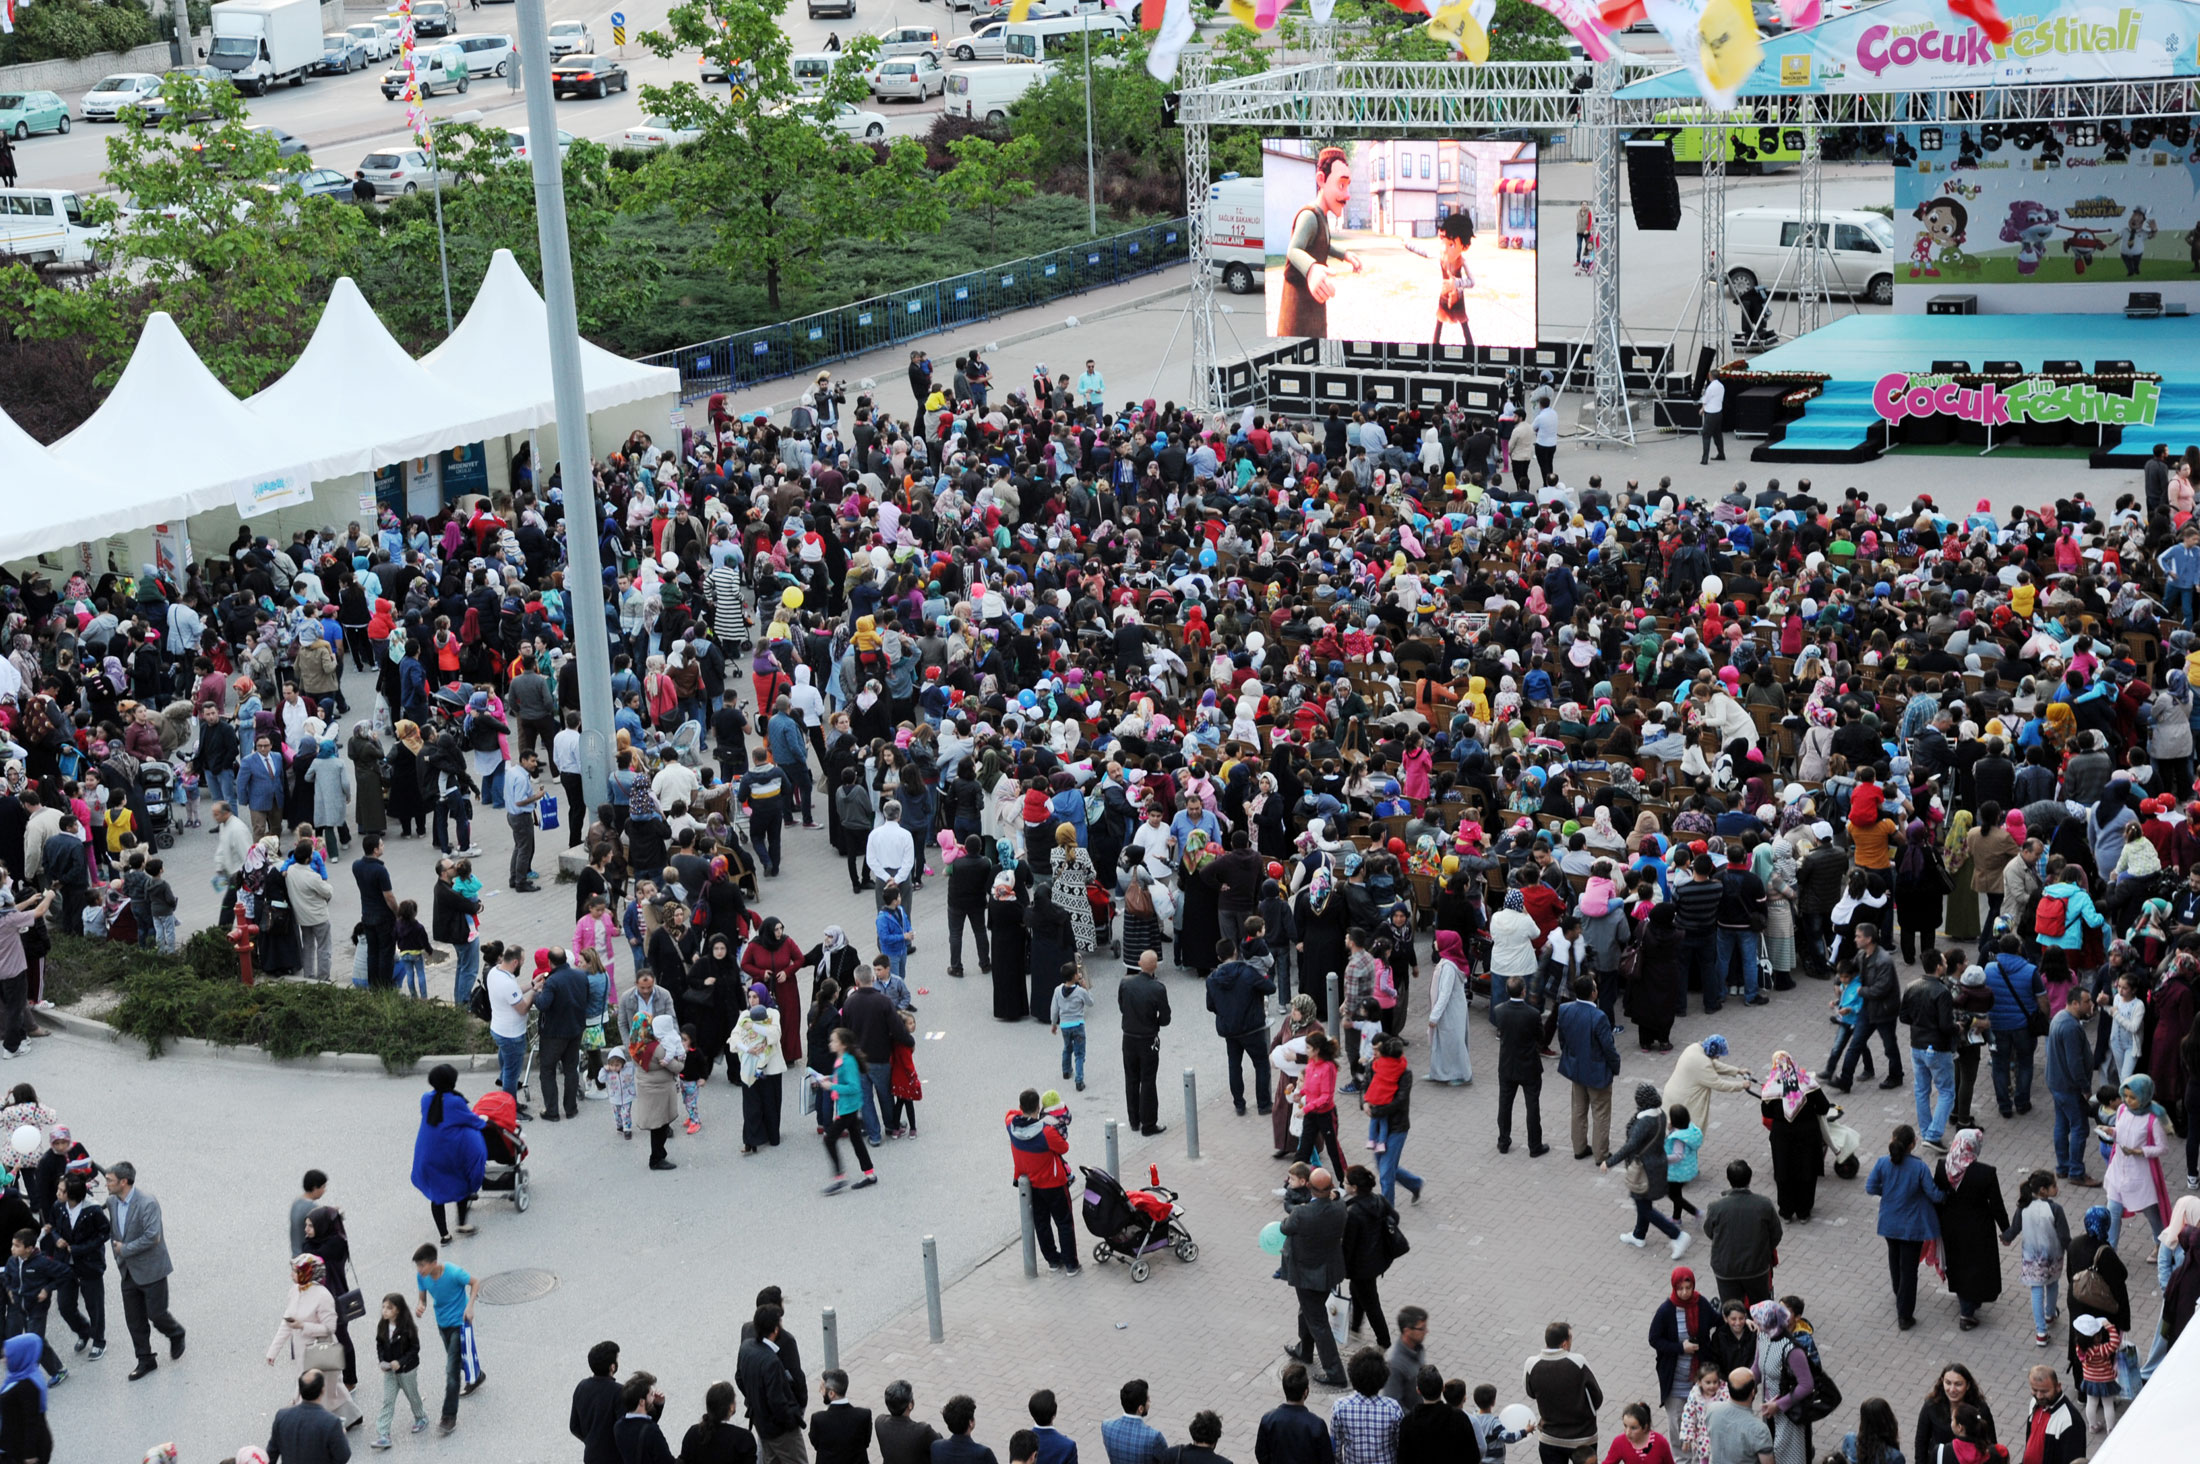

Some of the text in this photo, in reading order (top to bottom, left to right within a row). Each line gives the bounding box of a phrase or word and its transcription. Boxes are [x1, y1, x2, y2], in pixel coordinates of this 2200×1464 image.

[1892, 21, 1935, 37] Konya
[1856, 24, 1993, 77] Çocuk
[1232, 224, 1246, 236] 112
[1908, 376, 1952, 389] Konya
[1872, 372, 2161, 427] Çocuk Festivali
